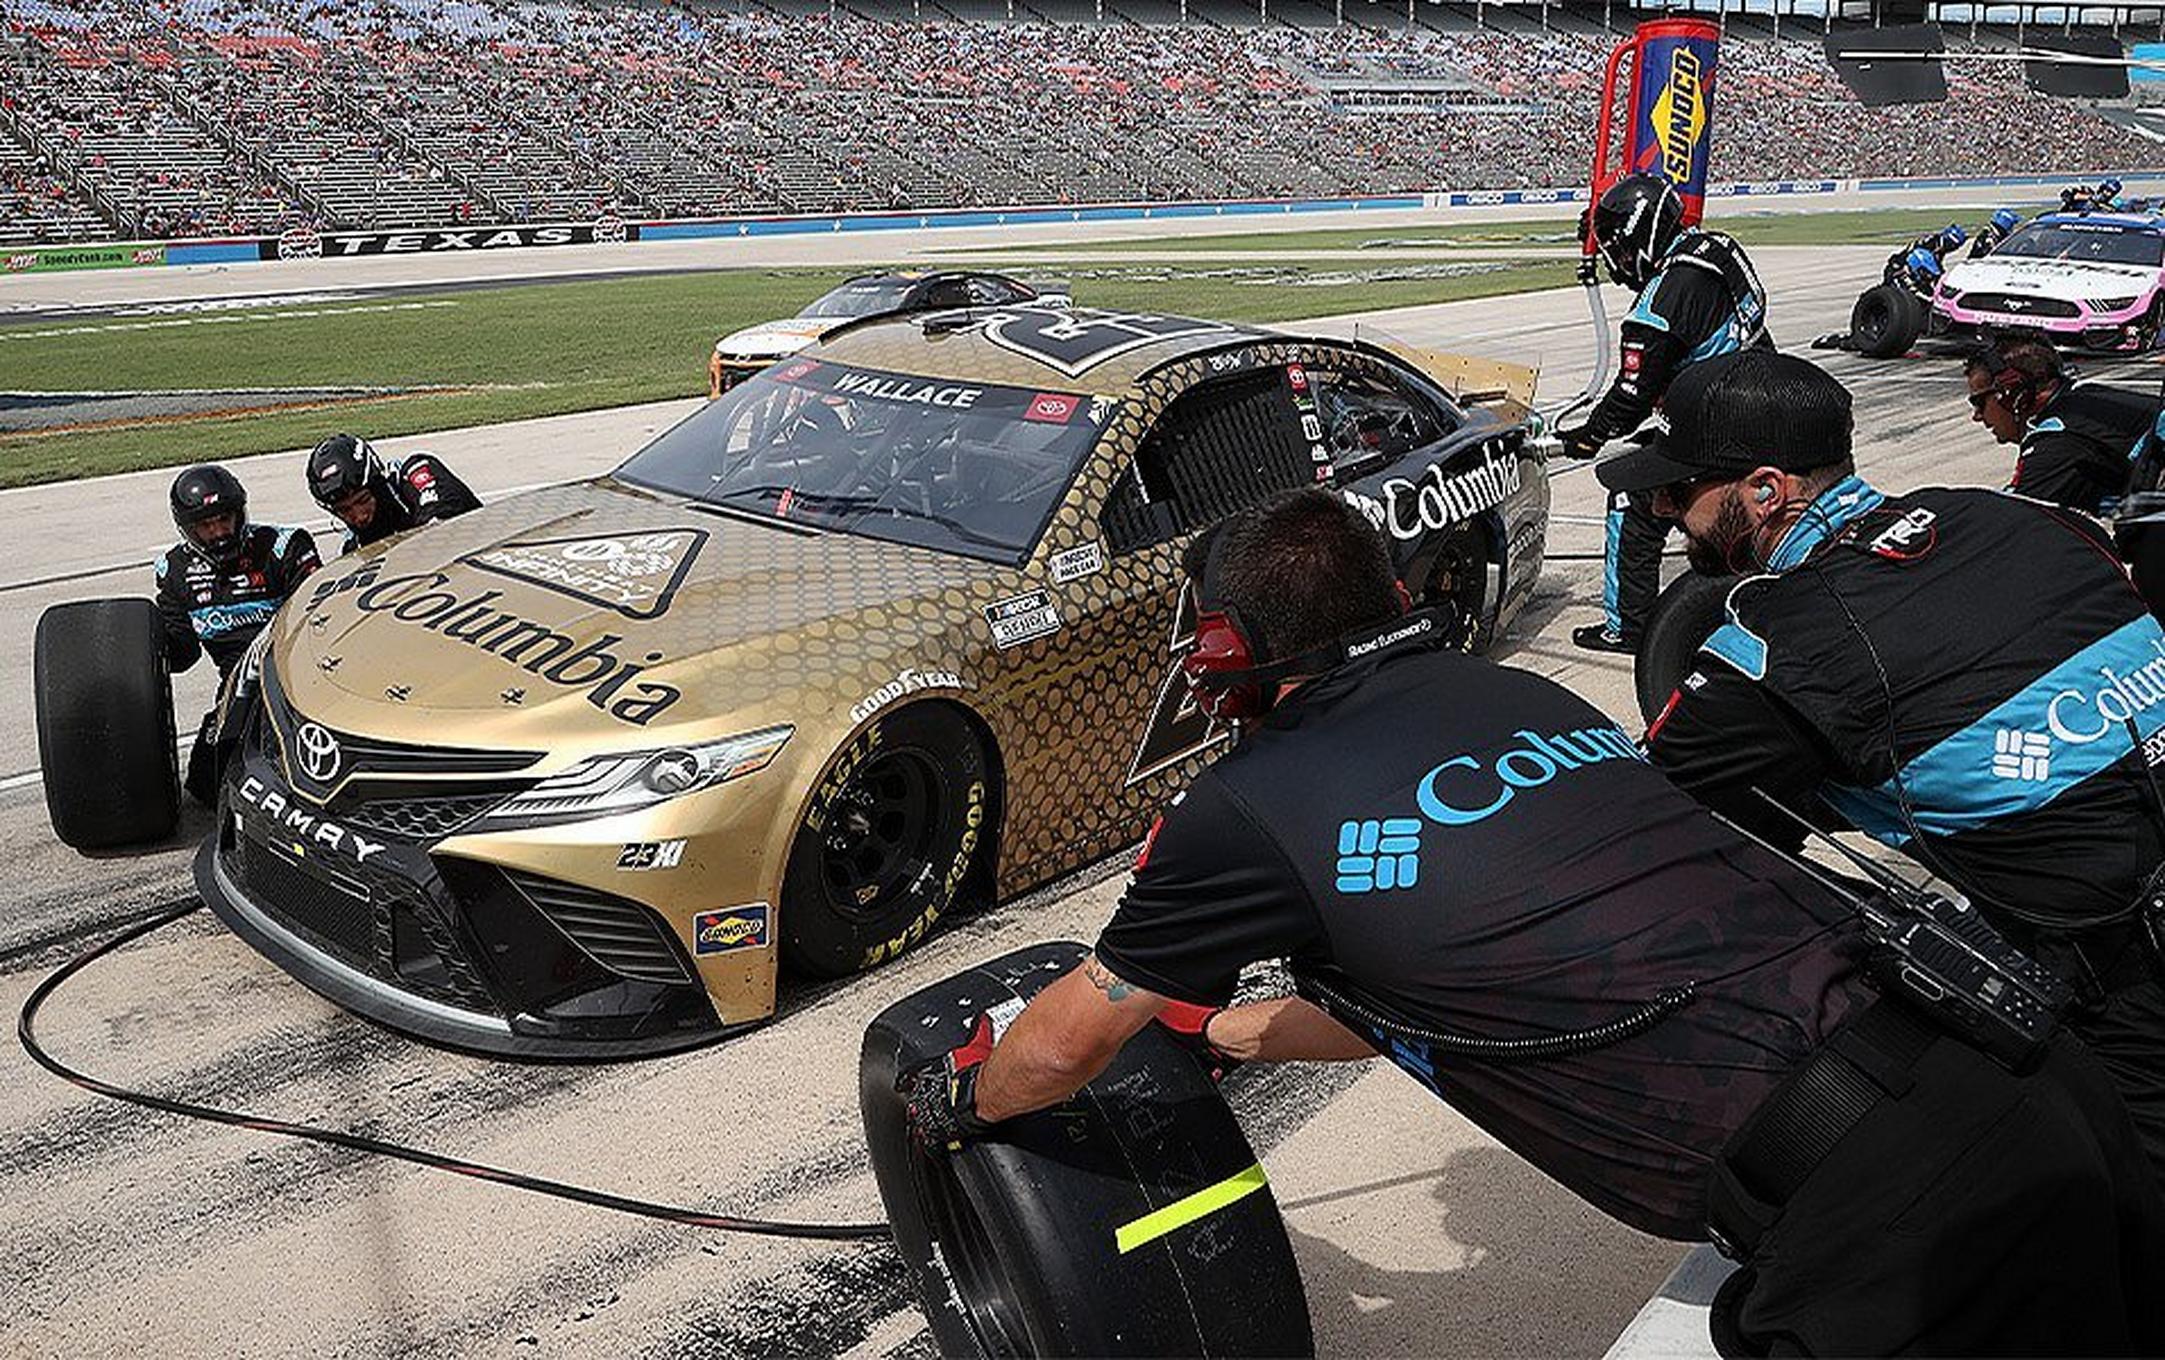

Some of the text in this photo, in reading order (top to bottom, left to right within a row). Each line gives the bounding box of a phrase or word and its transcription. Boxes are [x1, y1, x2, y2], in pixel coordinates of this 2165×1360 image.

[1663, 50, 1698, 180] SUNOCO
[335, 227, 573, 255] TEXAS
[833, 372, 982, 408] WALLACE
[1383, 440, 1521, 540] Columbia
[357, 572, 682, 726] Columbia
[850, 669, 960, 724] GOODYEAR
[240, 776, 386, 863] CAMRY
[806, 722, 884, 833] EAGLE
[702, 920, 764, 942] SUNOCO
